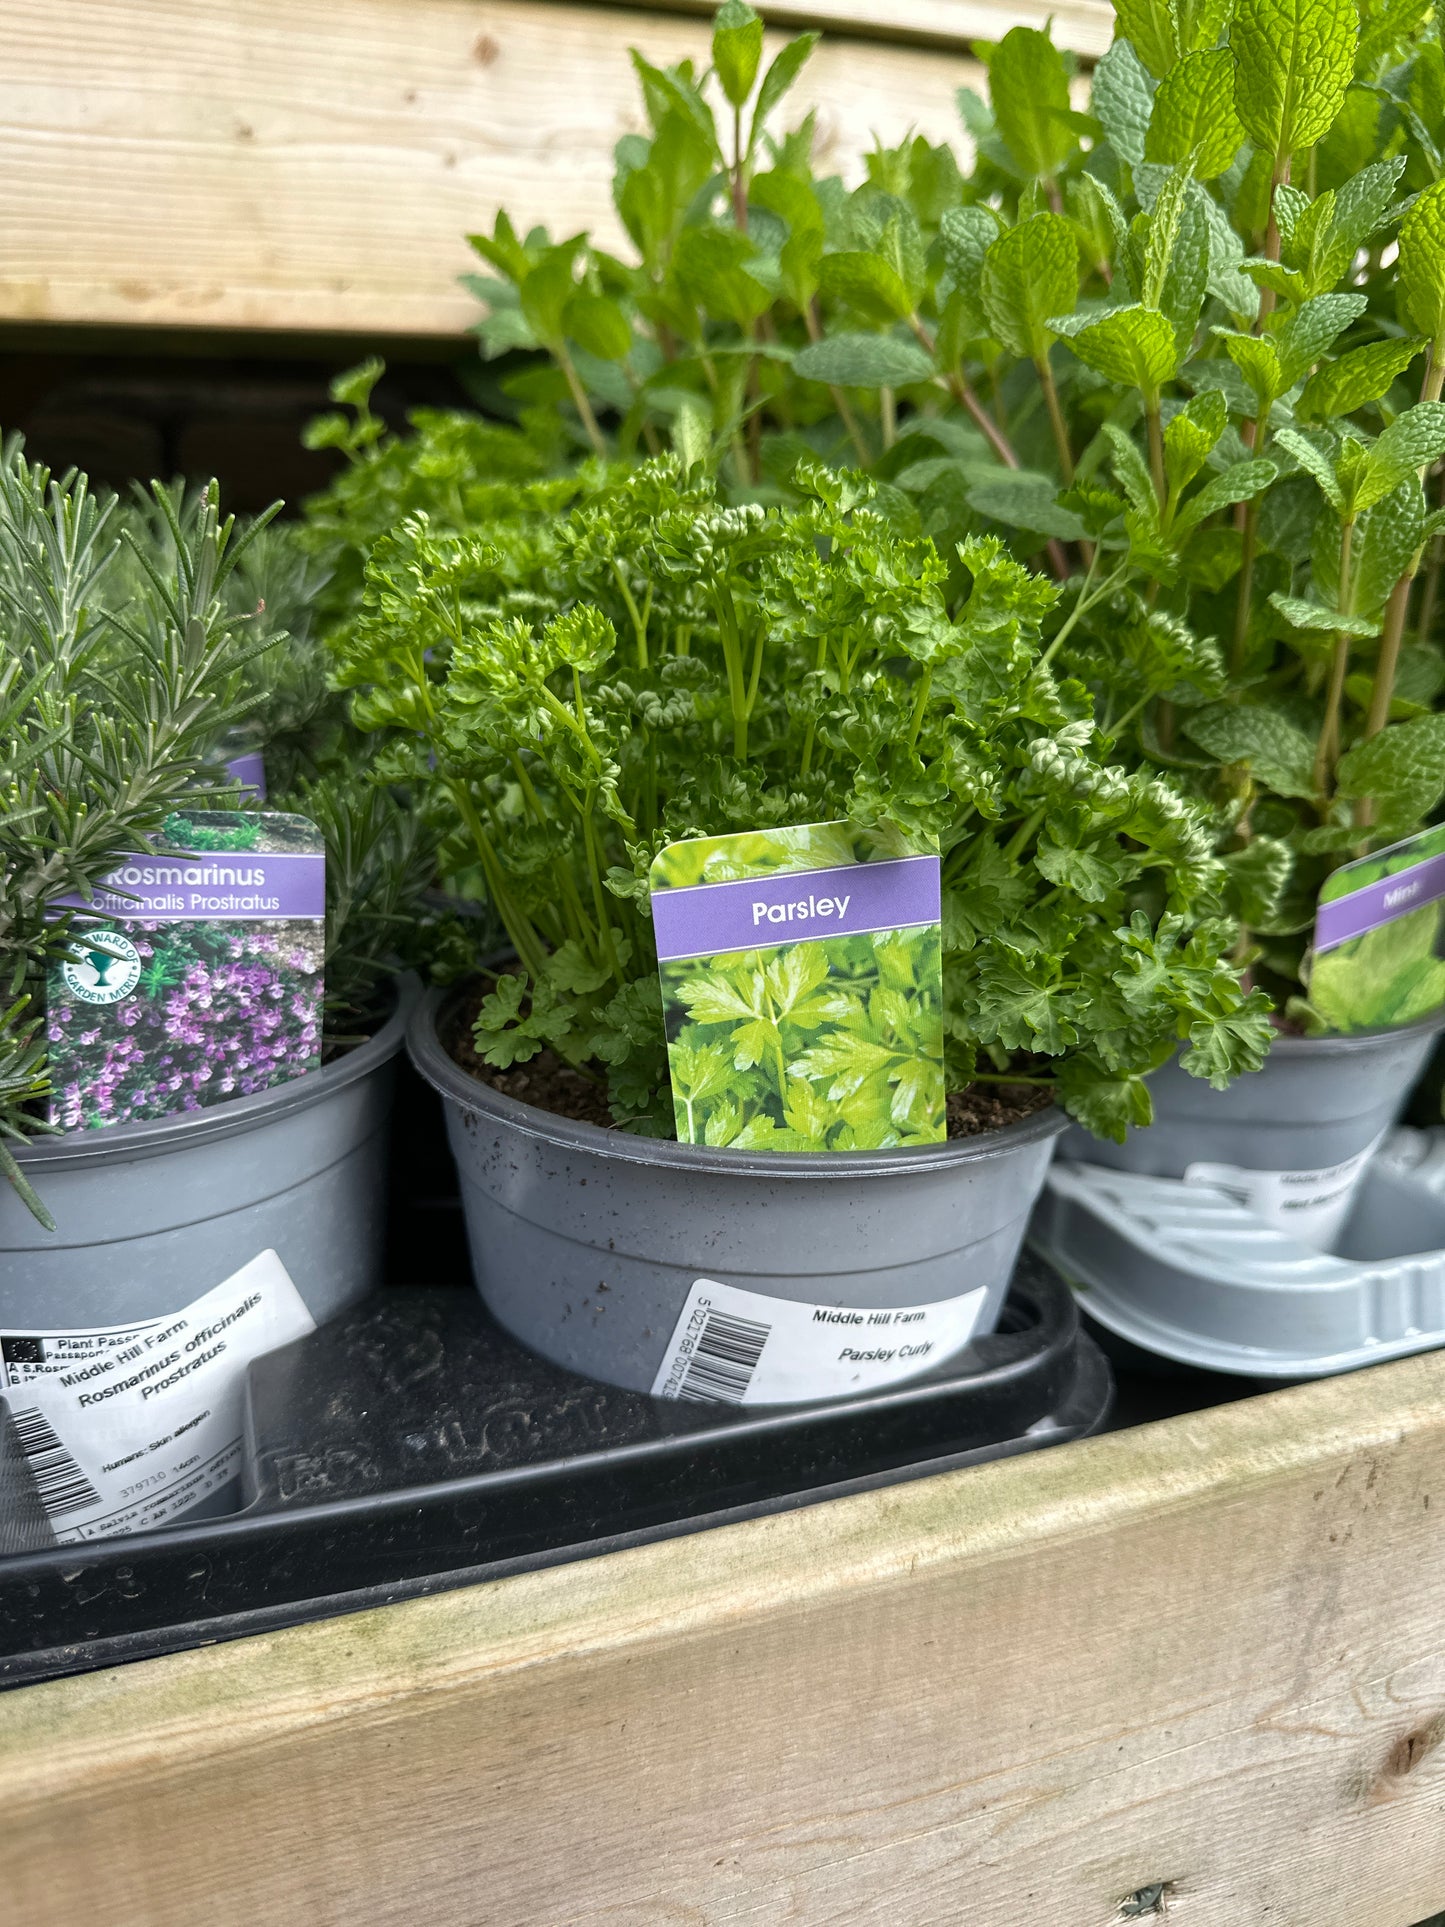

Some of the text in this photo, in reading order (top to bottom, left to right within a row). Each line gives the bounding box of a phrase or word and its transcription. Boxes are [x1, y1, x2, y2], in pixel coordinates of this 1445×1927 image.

[107, 864, 265, 886] Rosmarinus
[92, 893, 280, 911] officinalis Prostratus
[1383, 880, 1420, 909] Mint
[752, 895, 850, 926] Parsley
[126, 949, 139, 965] OF
[68, 971, 138, 1002] GARDEN MERIT
[698, 1297, 711, 1306] 5
[812, 1310, 926, 1325] Middle Hill Farm
[46, 1349, 110, 1360] Passapor
[58, 1339, 93, 1350] Plant
[59, 1319, 189, 1387] Middle Hill Farm
[78, 1292, 262, 1408] Rosmarinus officinalis
[838, 1341, 935, 1362] Parsley Curly
[9, 1362, 19, 1373] A
[141, 1340, 228, 1400] Prostratus
[11, 1375, 21, 1385] B
[102, 1409, 211, 1473] Humans: Skin allergen
[120, 1454, 201, 1498] 379710 14cm
[100, 1511, 138, 1531] Salvia
